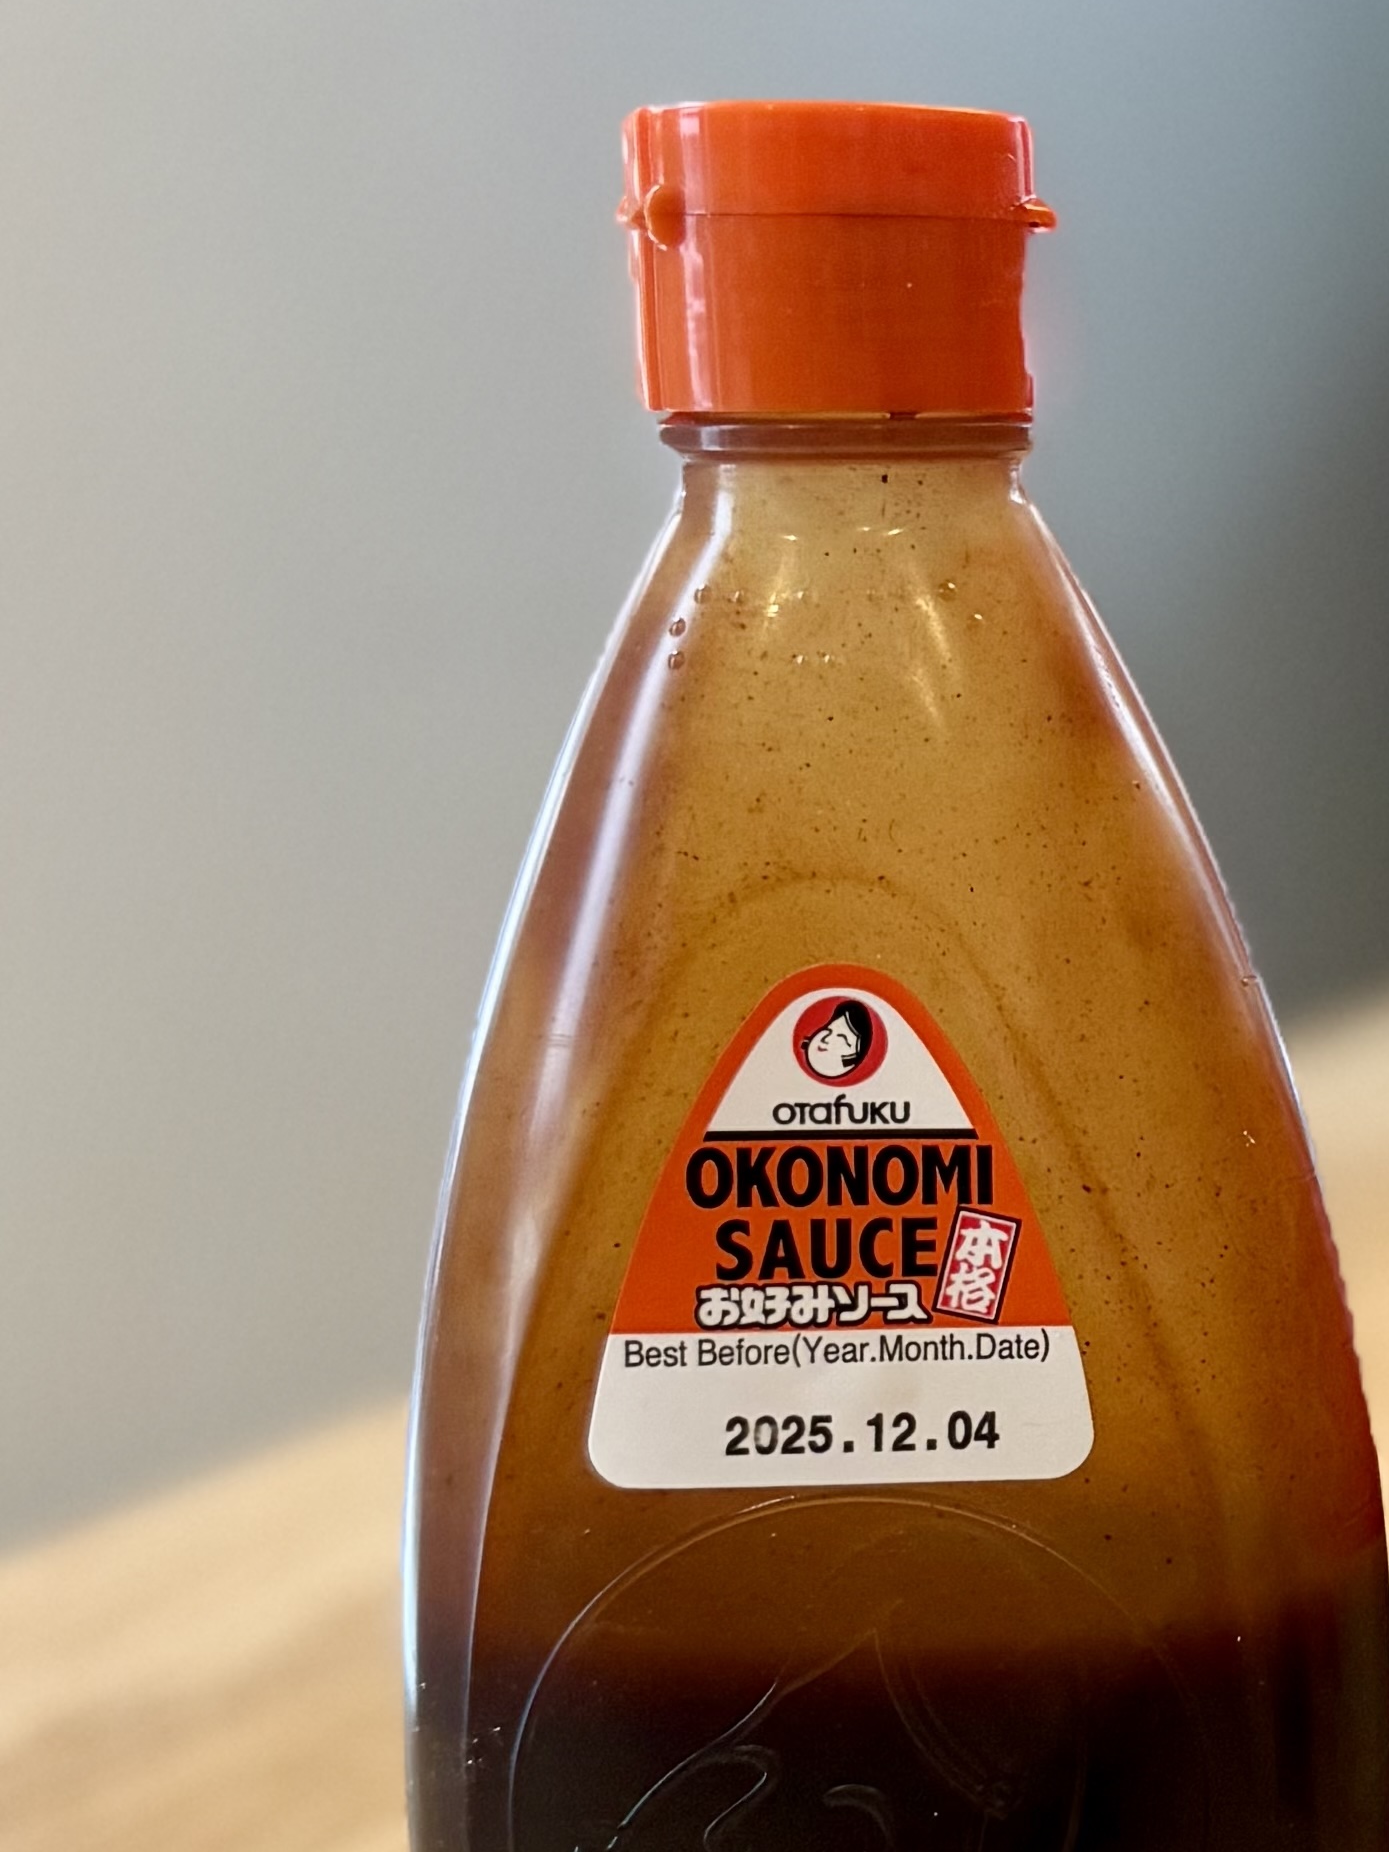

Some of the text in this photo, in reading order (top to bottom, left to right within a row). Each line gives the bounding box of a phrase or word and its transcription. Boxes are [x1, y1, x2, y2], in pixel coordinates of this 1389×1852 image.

[686, 1144, 993, 1209] OKONOMI
[715, 1217, 938, 1281] SAUCE
[945, 1219, 1009, 1313] 本格
[698, 1282, 930, 1326] お好みソース
[624, 1339, 688, 1368] Best
[724, 1410, 1000, 1456] 2025.12.04
